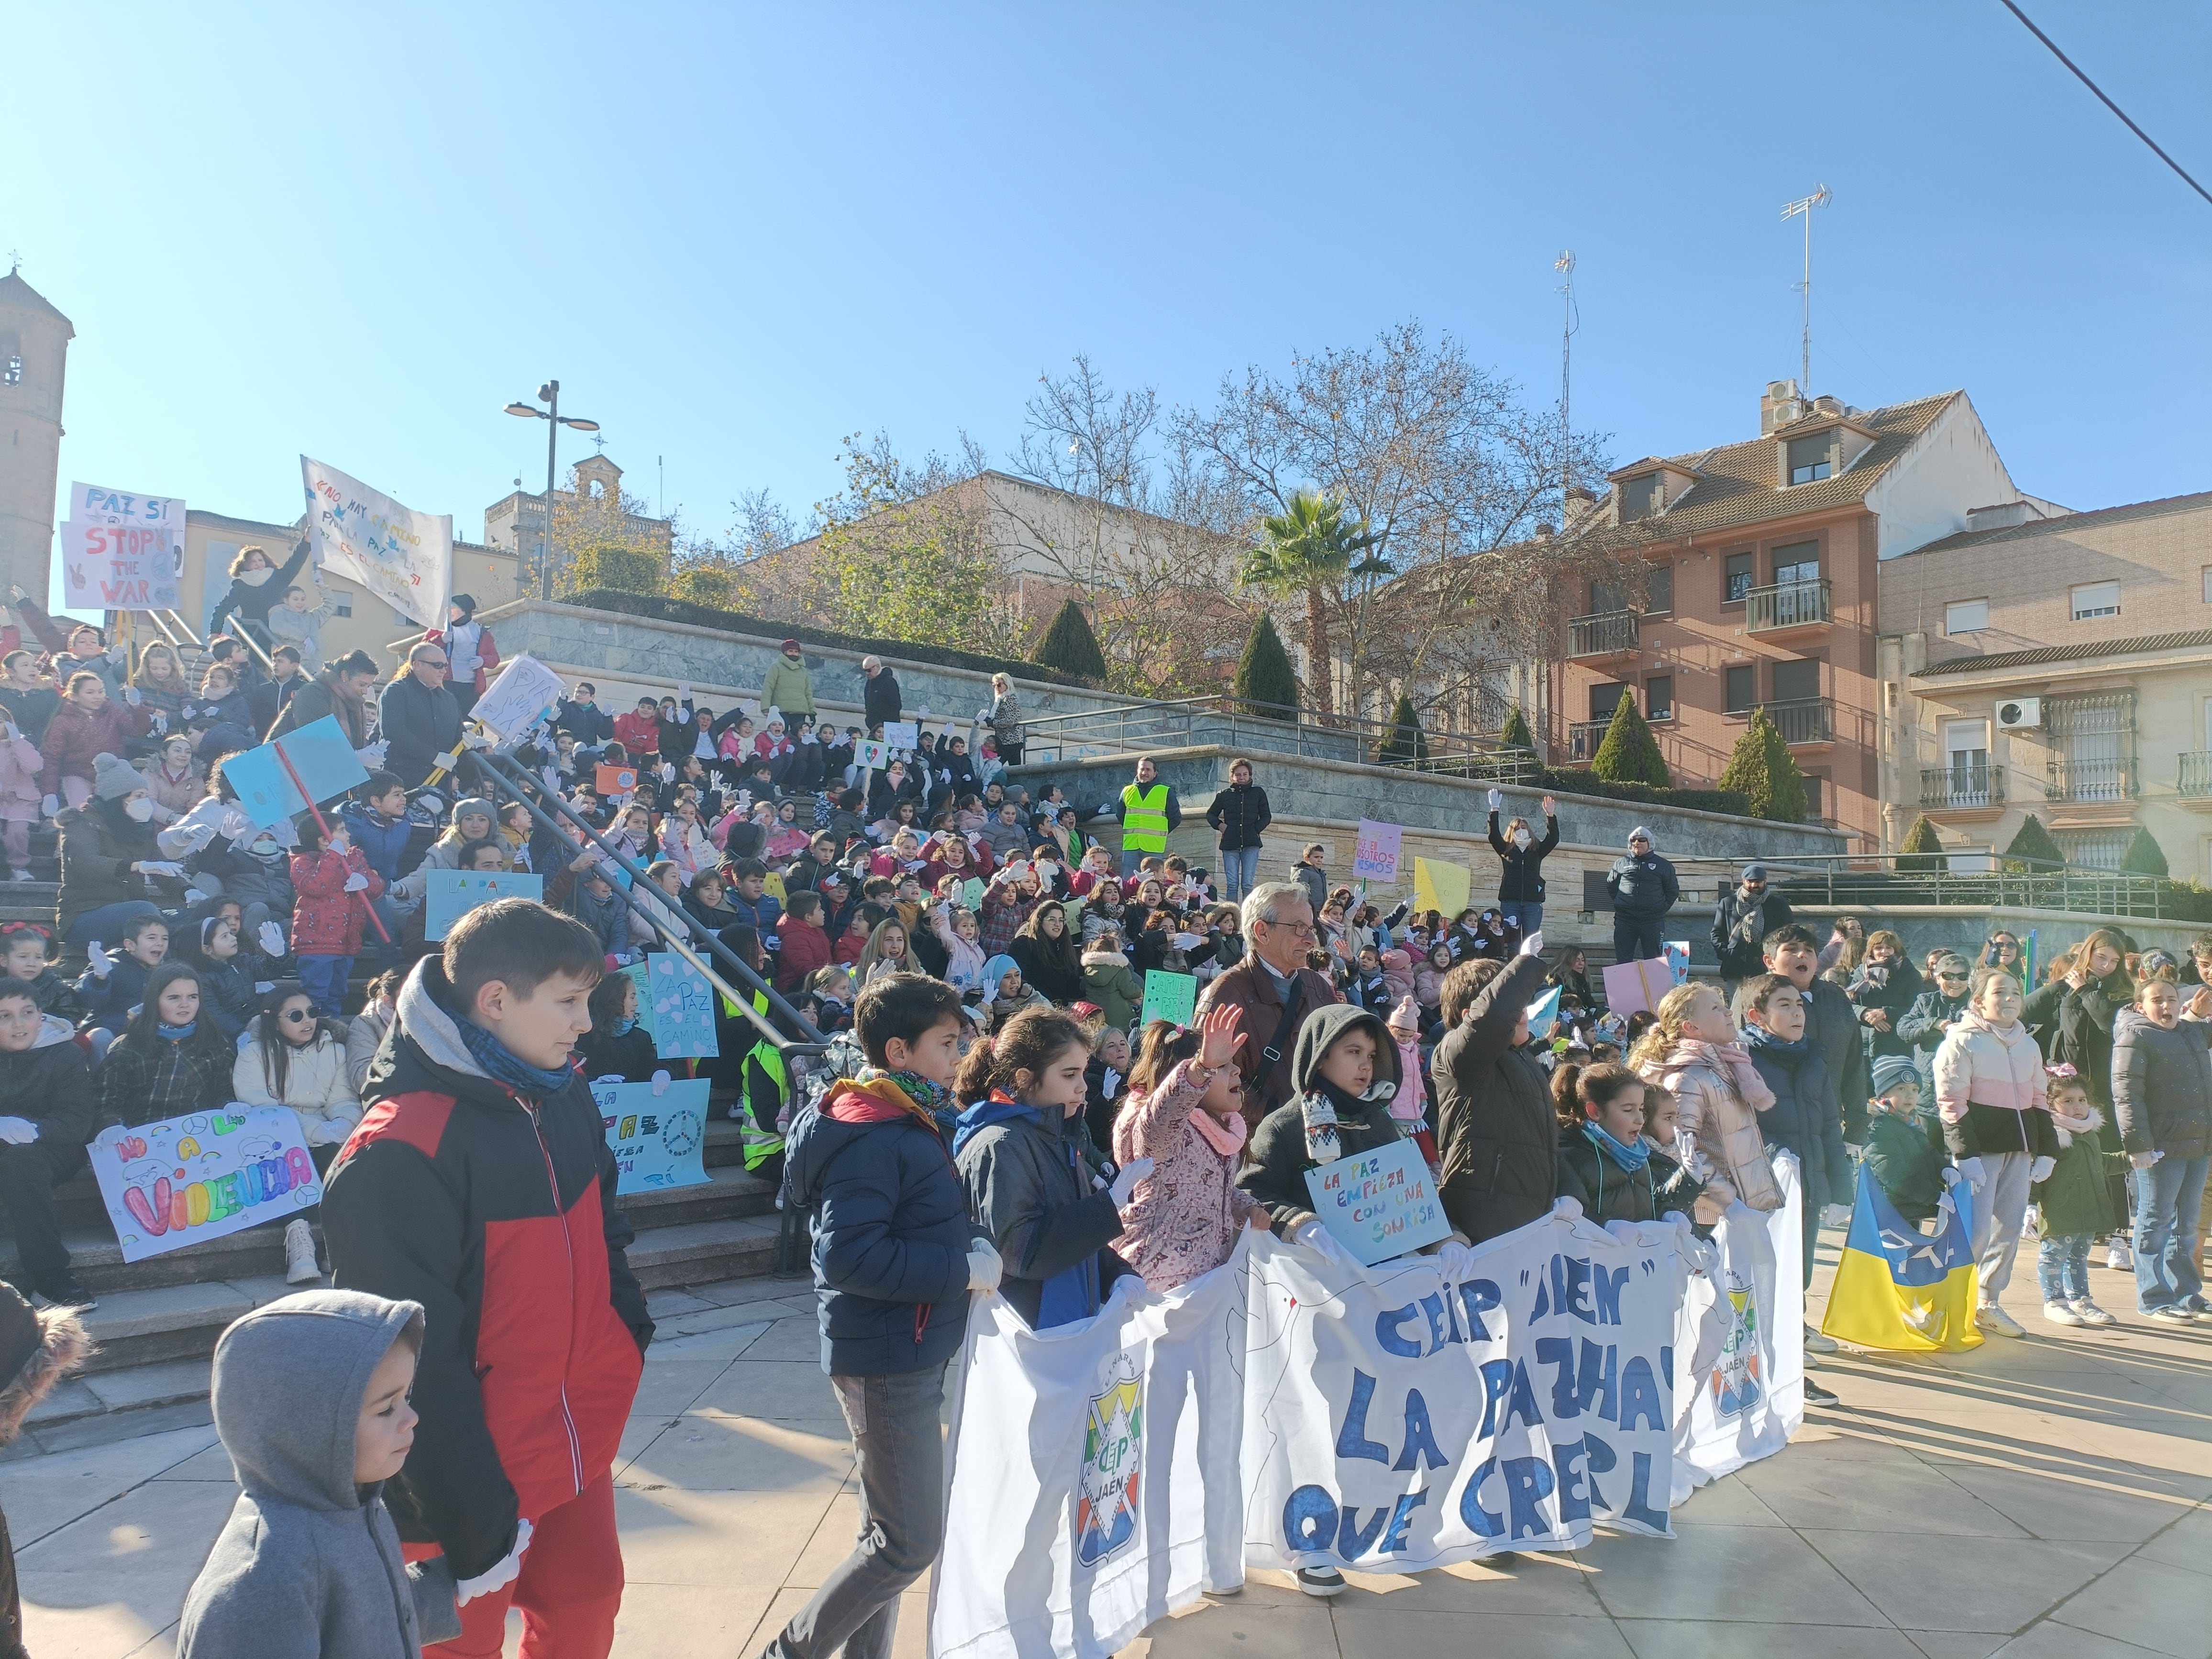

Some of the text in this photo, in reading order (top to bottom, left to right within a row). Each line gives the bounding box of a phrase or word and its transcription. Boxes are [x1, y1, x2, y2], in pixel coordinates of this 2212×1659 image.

[85, 488, 172, 520] PAZ SÍ
[347, 498, 367, 519] HAY
[371, 514, 421, 546] CAMINO
[85, 527, 155, 555] STOP
[340, 542, 354, 556] ES
[358, 553, 371, 567] EL
[346, 527, 358, 542] LA
[403, 559, 416, 572] LA
[110, 560, 139, 576] THE
[100, 579, 150, 604] WAR
[449, 878, 467, 894] LA
[654, 976, 676, 993] LA
[677, 982, 710, 1010] PAZ
[660, 1014, 700, 1025] ES EL
[661, 1026, 711, 1043] CAMINO
[593, 1092, 617, 1107] LA
[116, 1136, 147, 1162] NO
[178, 1137, 201, 1161] A
[1324, 1158, 1379, 1190] LA PAZ
[123, 1147, 312, 1236] VIOLENCIA
[1353, 1180, 1424, 1222] CON UNA
[1725, 1271, 1744, 1288] ARES
[1105, 1353, 1135, 1387] LINARES
[1724, 1356, 1745, 1374] JAÉN
[1337, 1367, 1449, 1472] LA
[1477, 1337, 1581, 1443] PAZ
[1095, 1476, 1124, 1503] JAÉN
[1111, 1460, 1136, 1522] PRIMARIA
[1087, 1489, 1106, 1532] INFANTIL
[1282, 1484, 1430, 1562] QUE
